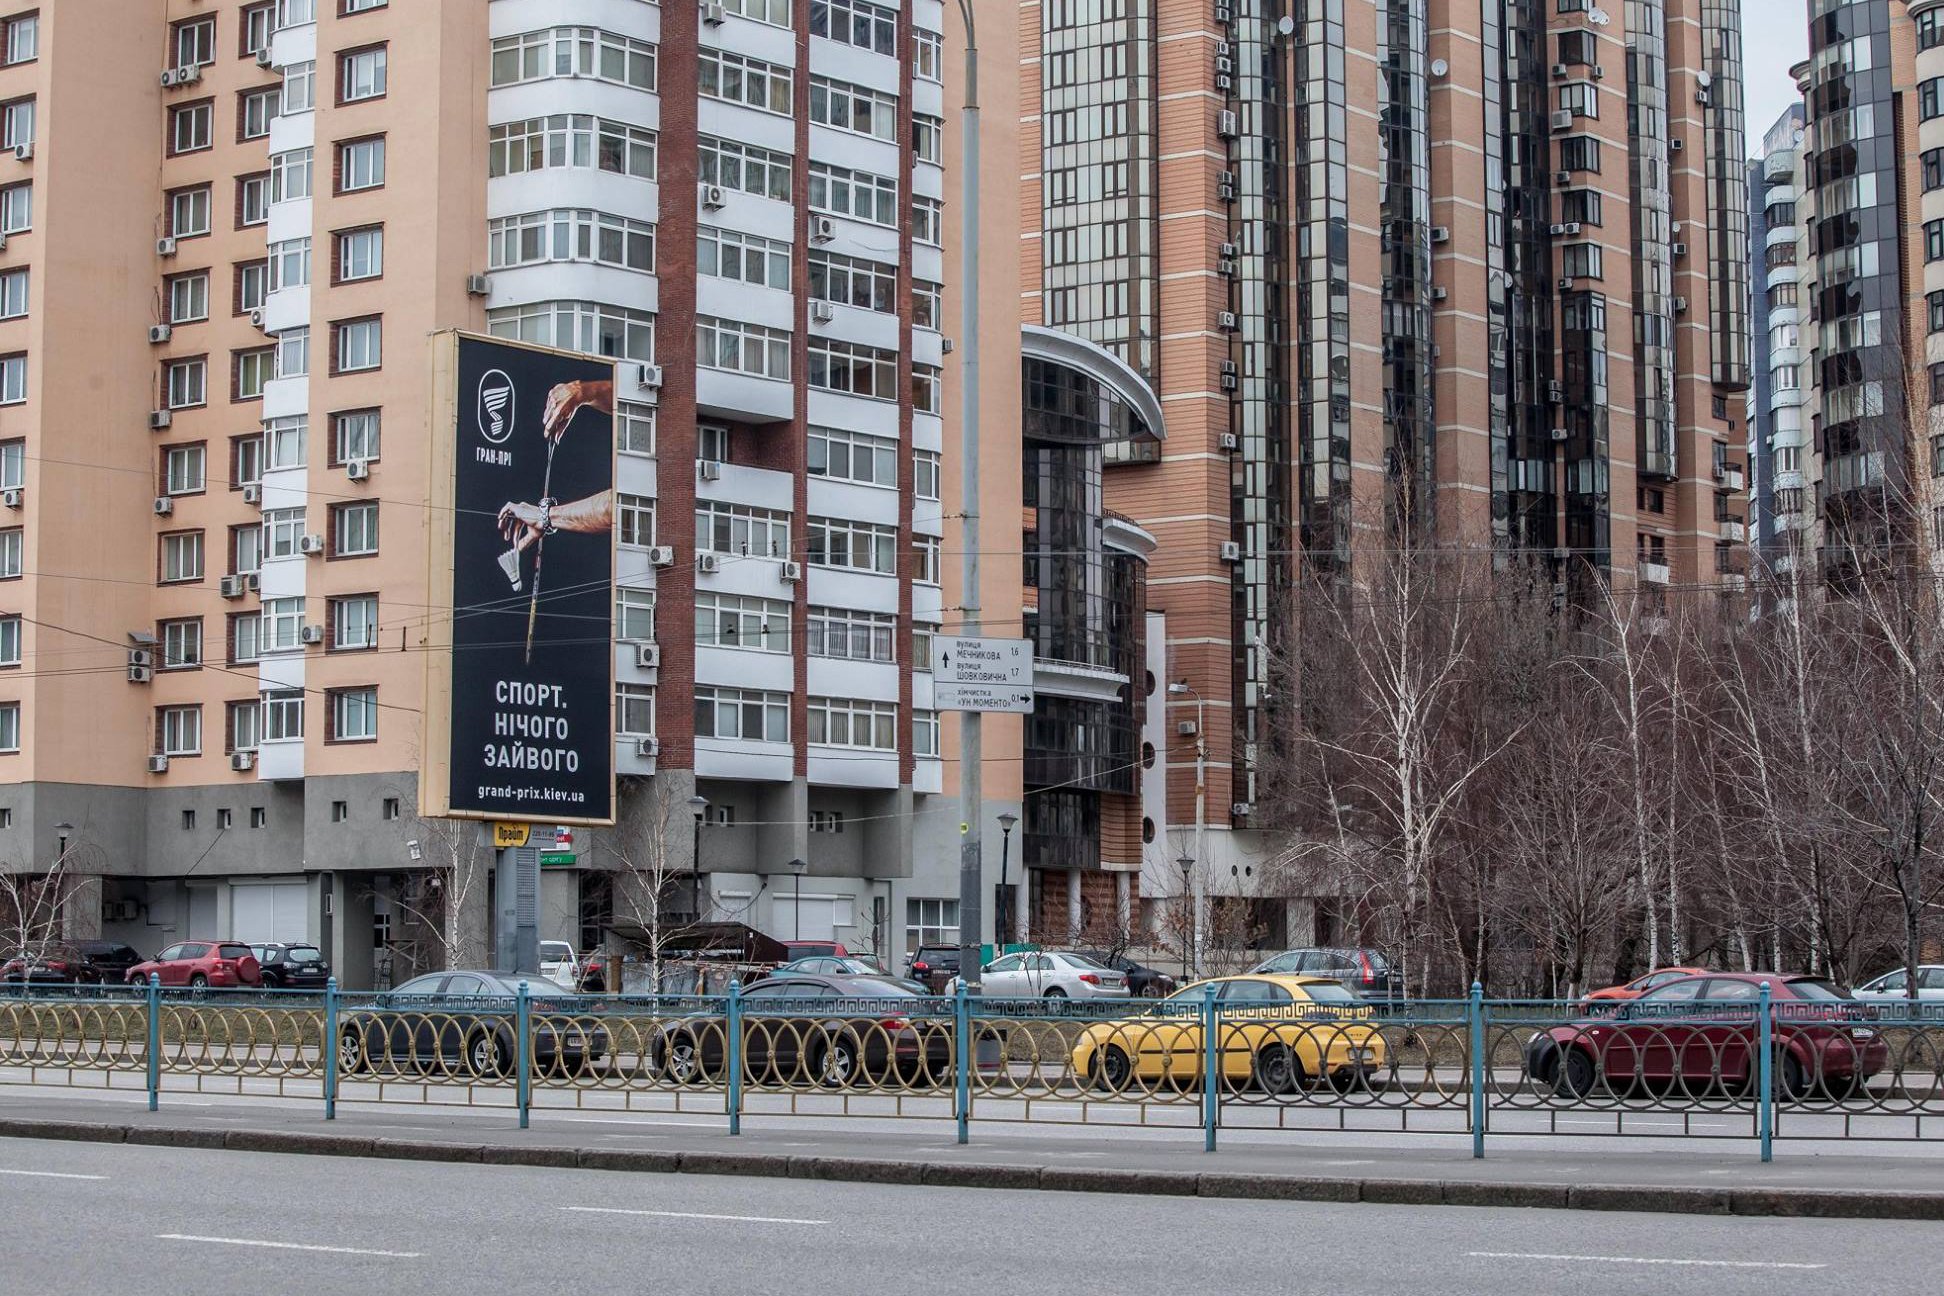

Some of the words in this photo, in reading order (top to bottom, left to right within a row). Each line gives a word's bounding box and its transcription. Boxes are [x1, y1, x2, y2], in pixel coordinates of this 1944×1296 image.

[476, 447, 512, 467] ГРАН-ПРІ
[956, 641, 981, 649] вулиця
[956, 650, 1001, 660] МЕЧНИКОВА
[956, 663, 981, 671] вулиця
[956, 671, 1007, 682] ШОВКОВИЧНА
[496, 680, 567, 709] СПОРТ.
[957, 688, 991, 697] хімчистка
[495, 712, 569, 740] НІЧОГО
[484, 741, 579, 773] ЗАЙВОГО
[478, 785, 585, 803] grand-prix.kiev.ua
